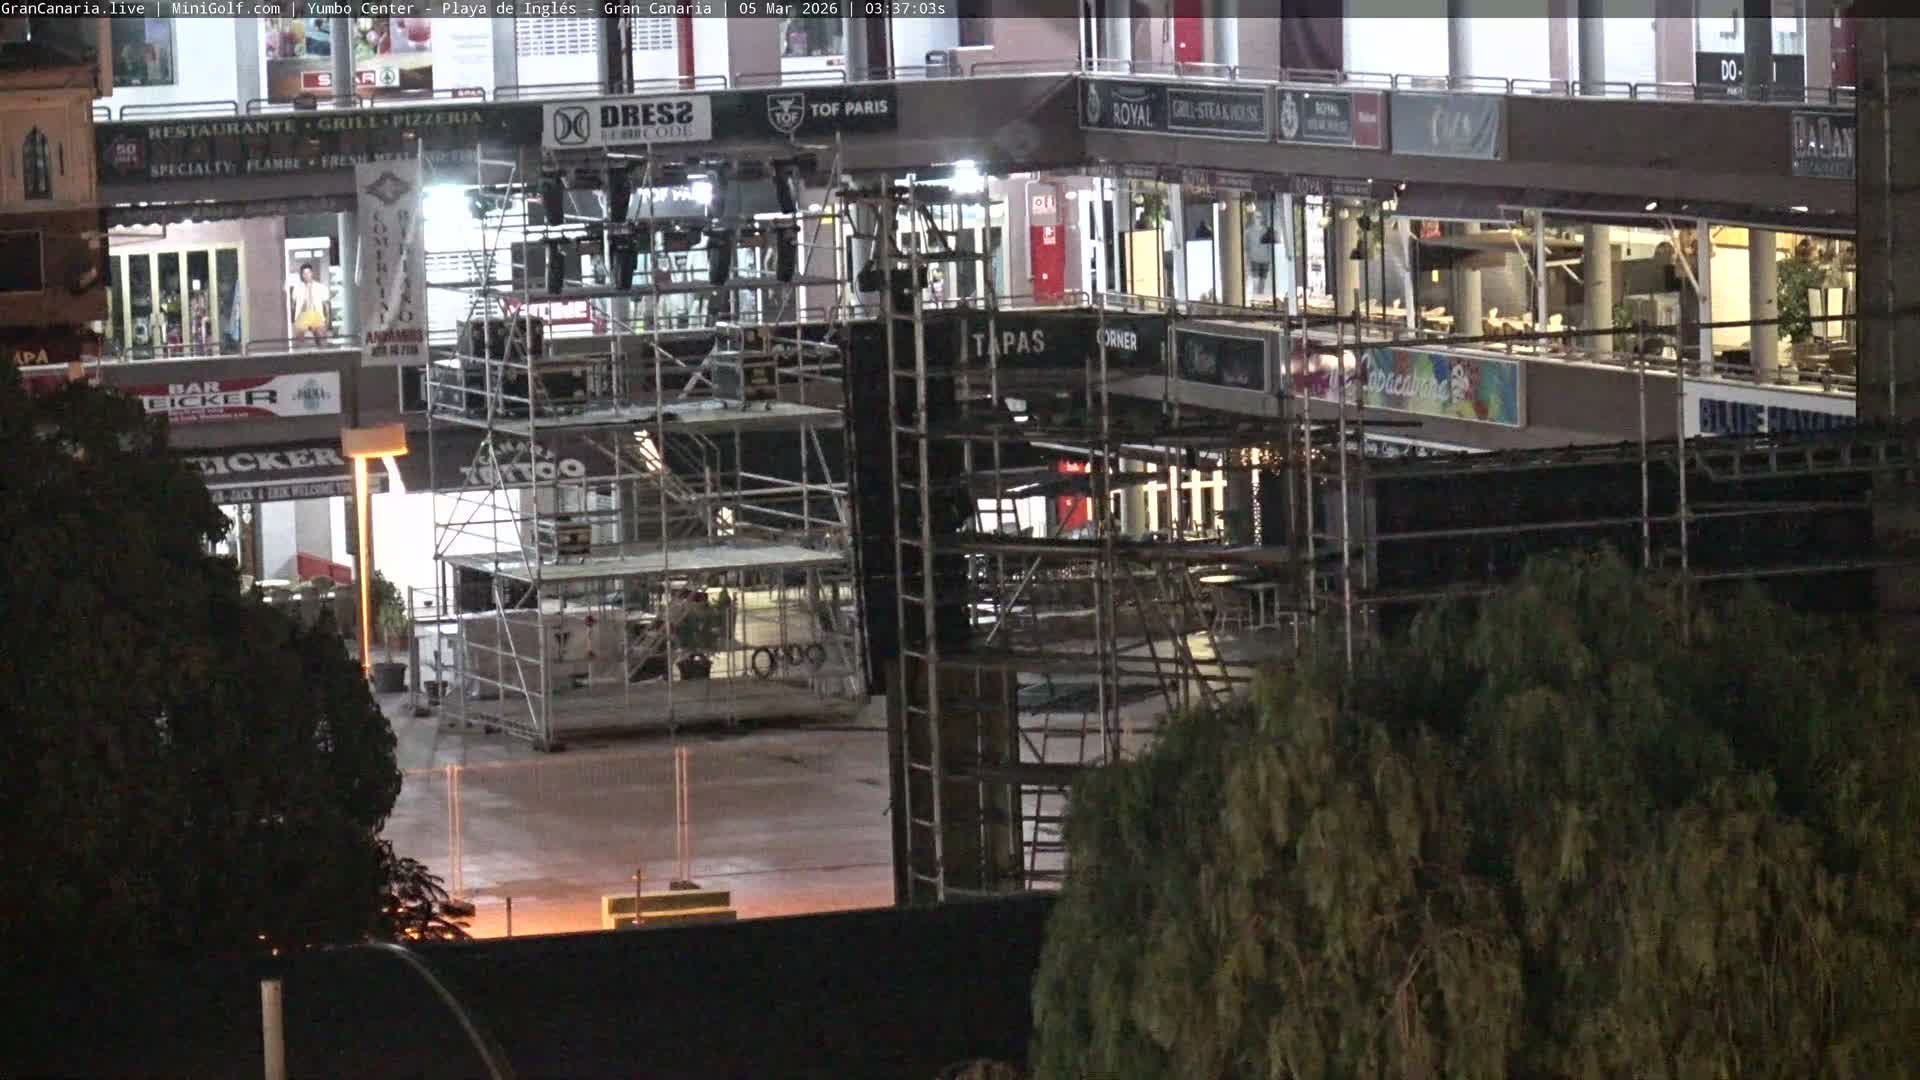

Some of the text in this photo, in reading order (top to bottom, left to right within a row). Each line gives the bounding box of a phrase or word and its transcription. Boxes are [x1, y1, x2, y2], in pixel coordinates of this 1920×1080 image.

[775, 111, 799, 125] TOF
[809, 99, 889, 117] TOF PARIS
[1112, 102, 1153, 128] ROYAL
[148, 111, 483, 140] RESTAURANTE GRILL PIZZERIA
[971, 328, 1046, 358] TAPAS
[1096, 328, 1137, 351] CORNER
[168, 380, 221, 395] BAR
